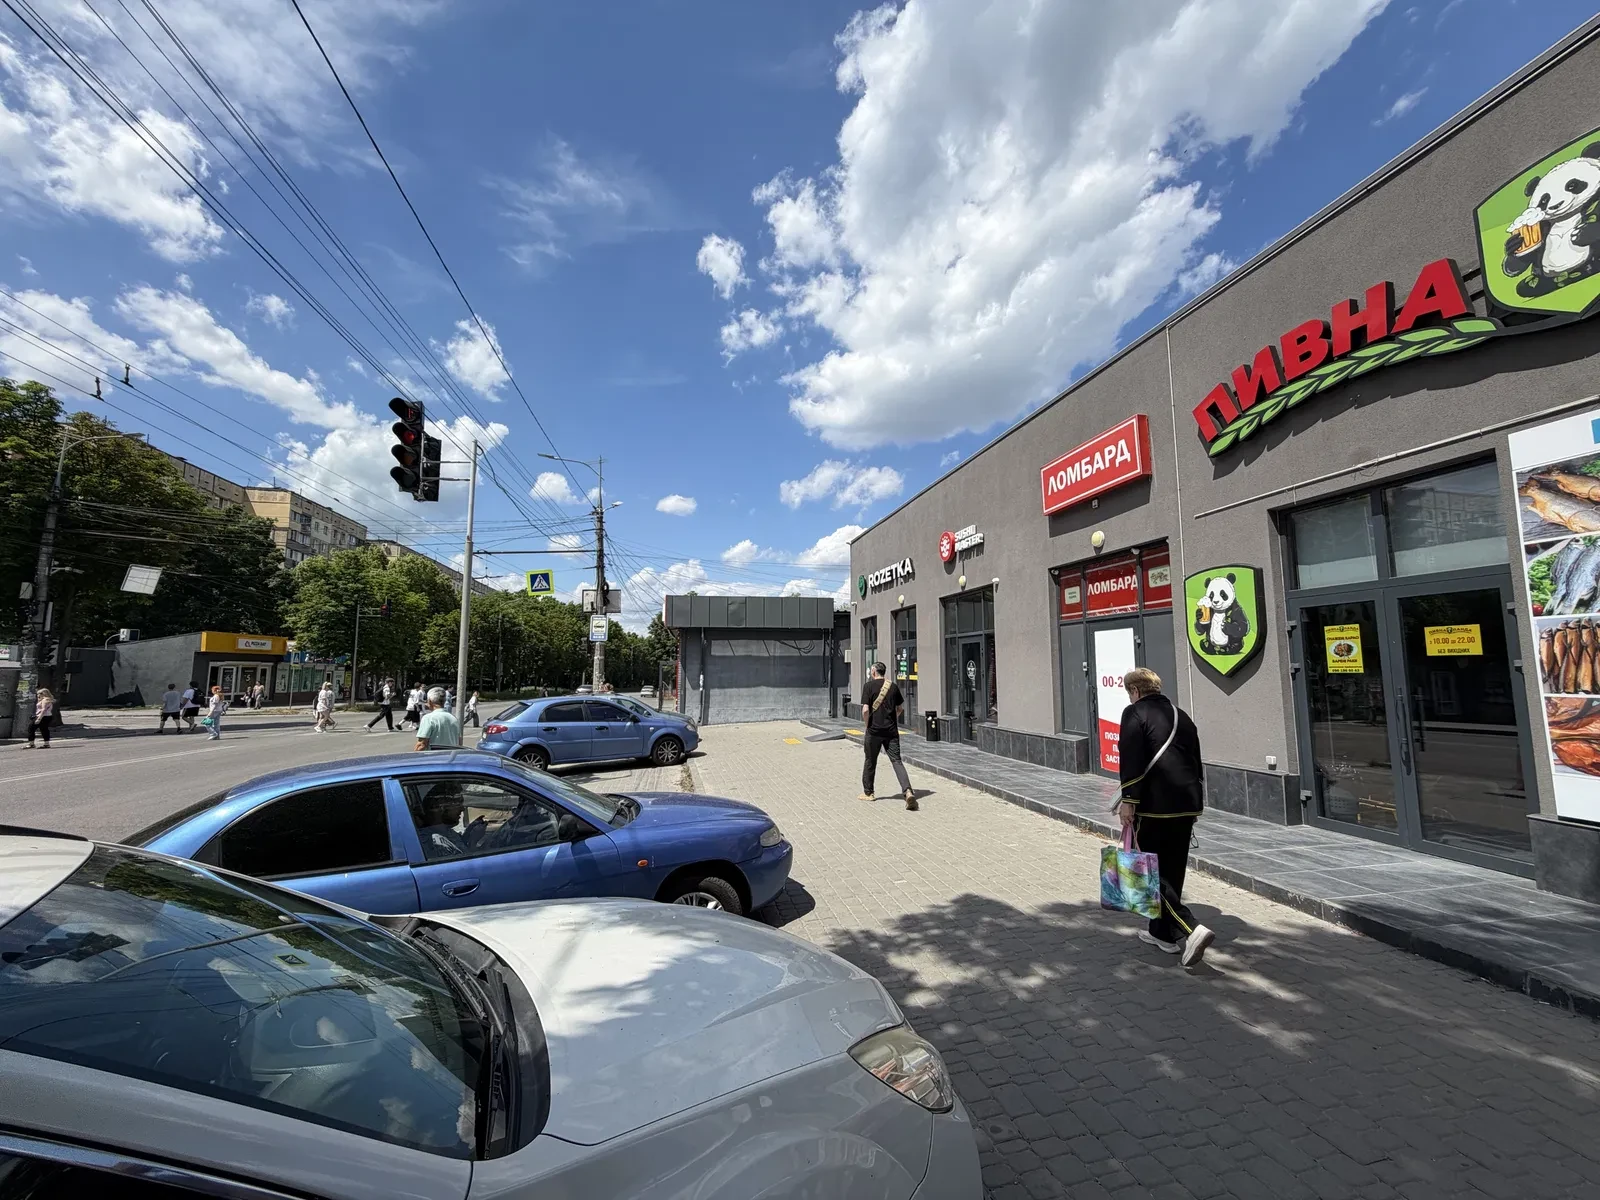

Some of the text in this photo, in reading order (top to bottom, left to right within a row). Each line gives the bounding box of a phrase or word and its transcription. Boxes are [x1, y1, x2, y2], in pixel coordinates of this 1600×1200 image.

[1192, 257, 1470, 442] ПИВНА
[1048, 438, 1131, 496] ЛОМБАРД
[868, 557, 914, 588] ROZETKA
[1087, 574, 1138, 596] ЛОМБАРД
[1433, 637, 1450, 645] 10.00
[1456, 636, 1476, 644] 22.00
